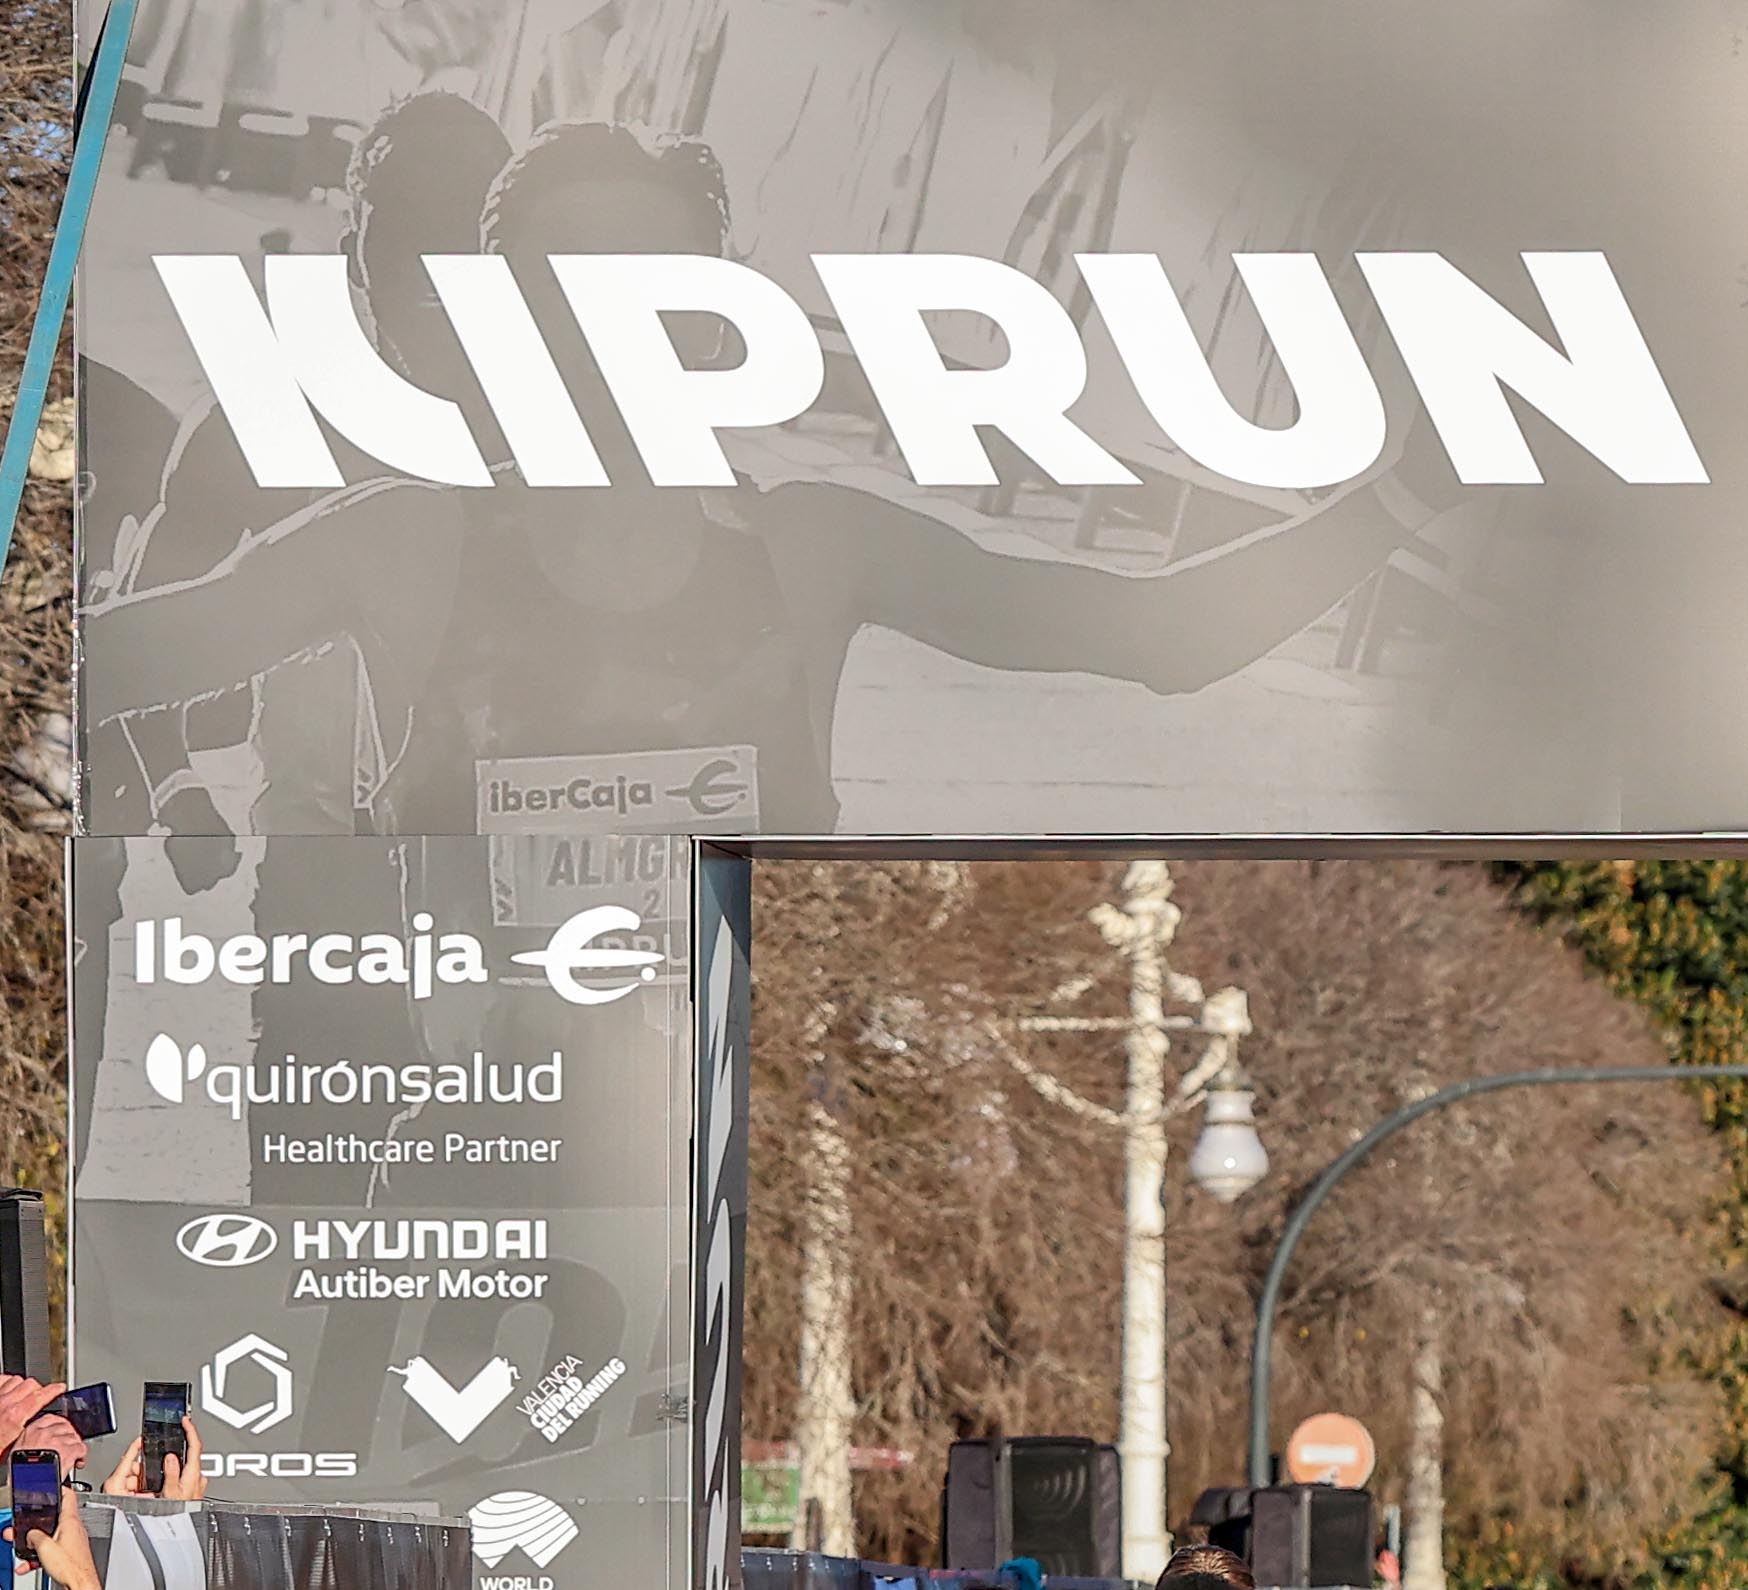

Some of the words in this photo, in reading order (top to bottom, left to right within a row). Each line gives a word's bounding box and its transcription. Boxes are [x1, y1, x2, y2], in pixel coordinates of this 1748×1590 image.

[150, 250, 1710, 489] KIPRUN
[490, 776, 652, 814] iberCaja
[135, 912, 489, 1000] Ibercaja
[205, 1050, 564, 1120] quirónsalud
[263, 1134, 435, 1163] Healthcare
[444, 1134, 563, 1163] Partner
[293, 1219, 548, 1260] HYUNDAI
[293, 1269, 427, 1300] Autiber
[437, 1269, 549, 1300] Motor
[516, 1354, 584, 1416] VALENCIA
[530, 1376, 584, 1433] CIUDAD
[540, 1411, 575, 1443] DEL
[564, 1357, 627, 1420] RUNNING
[200, 1452, 357, 1478] OROS
